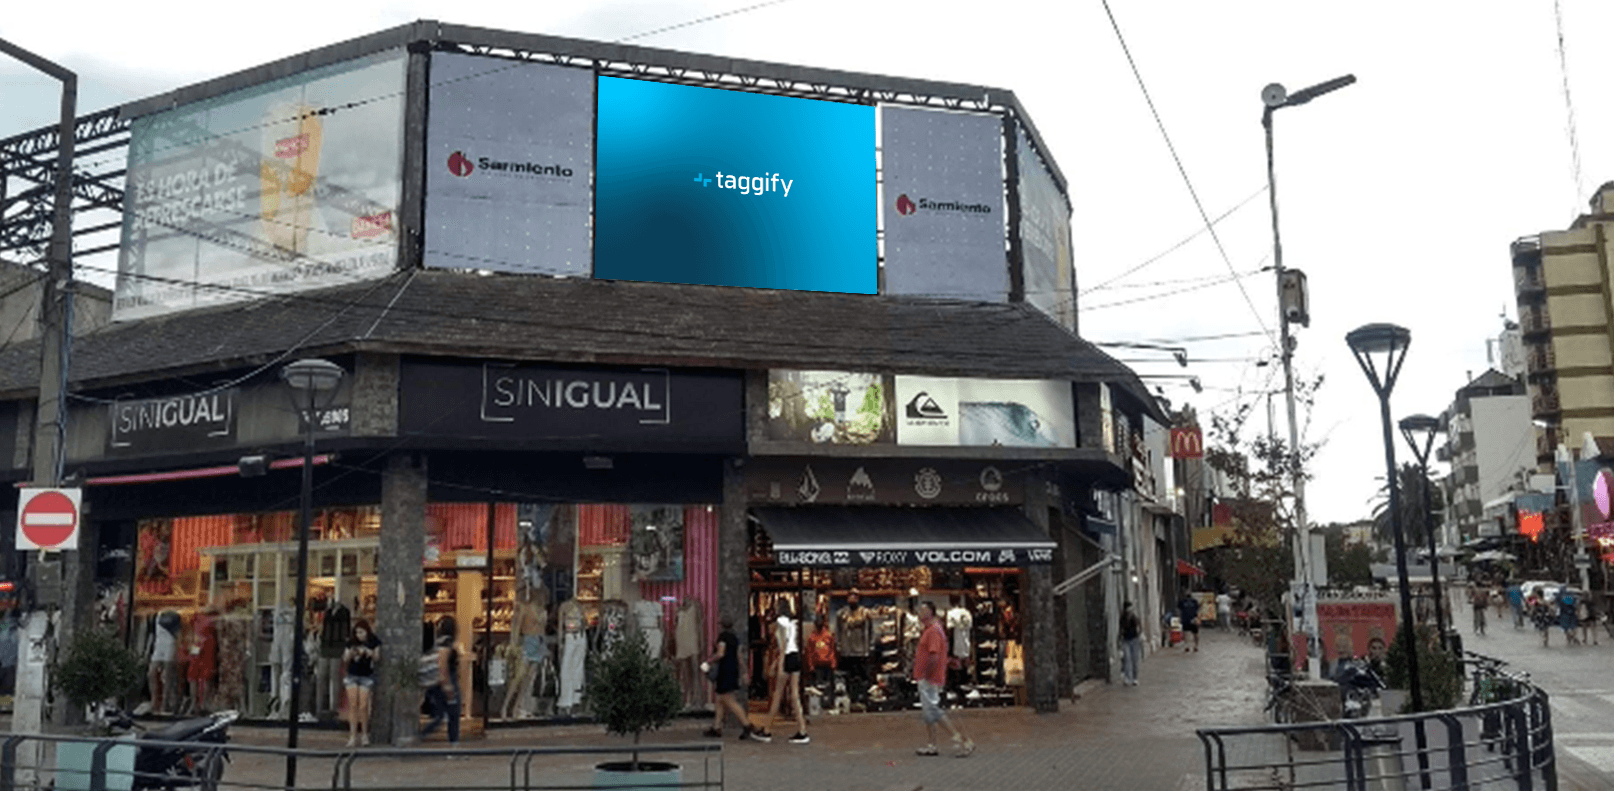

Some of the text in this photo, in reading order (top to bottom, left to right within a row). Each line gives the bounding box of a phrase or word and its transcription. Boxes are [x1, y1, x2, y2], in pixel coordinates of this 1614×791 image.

[478, 156, 573, 179] Sarmiento
[715, 170, 794, 198] taggify
[918, 197, 992, 215] Sarmiento
[494, 376, 661, 411] SINIGUAL
[118, 398, 225, 434] SINIGUAL
[914, 550, 992, 563] VOLCOM
